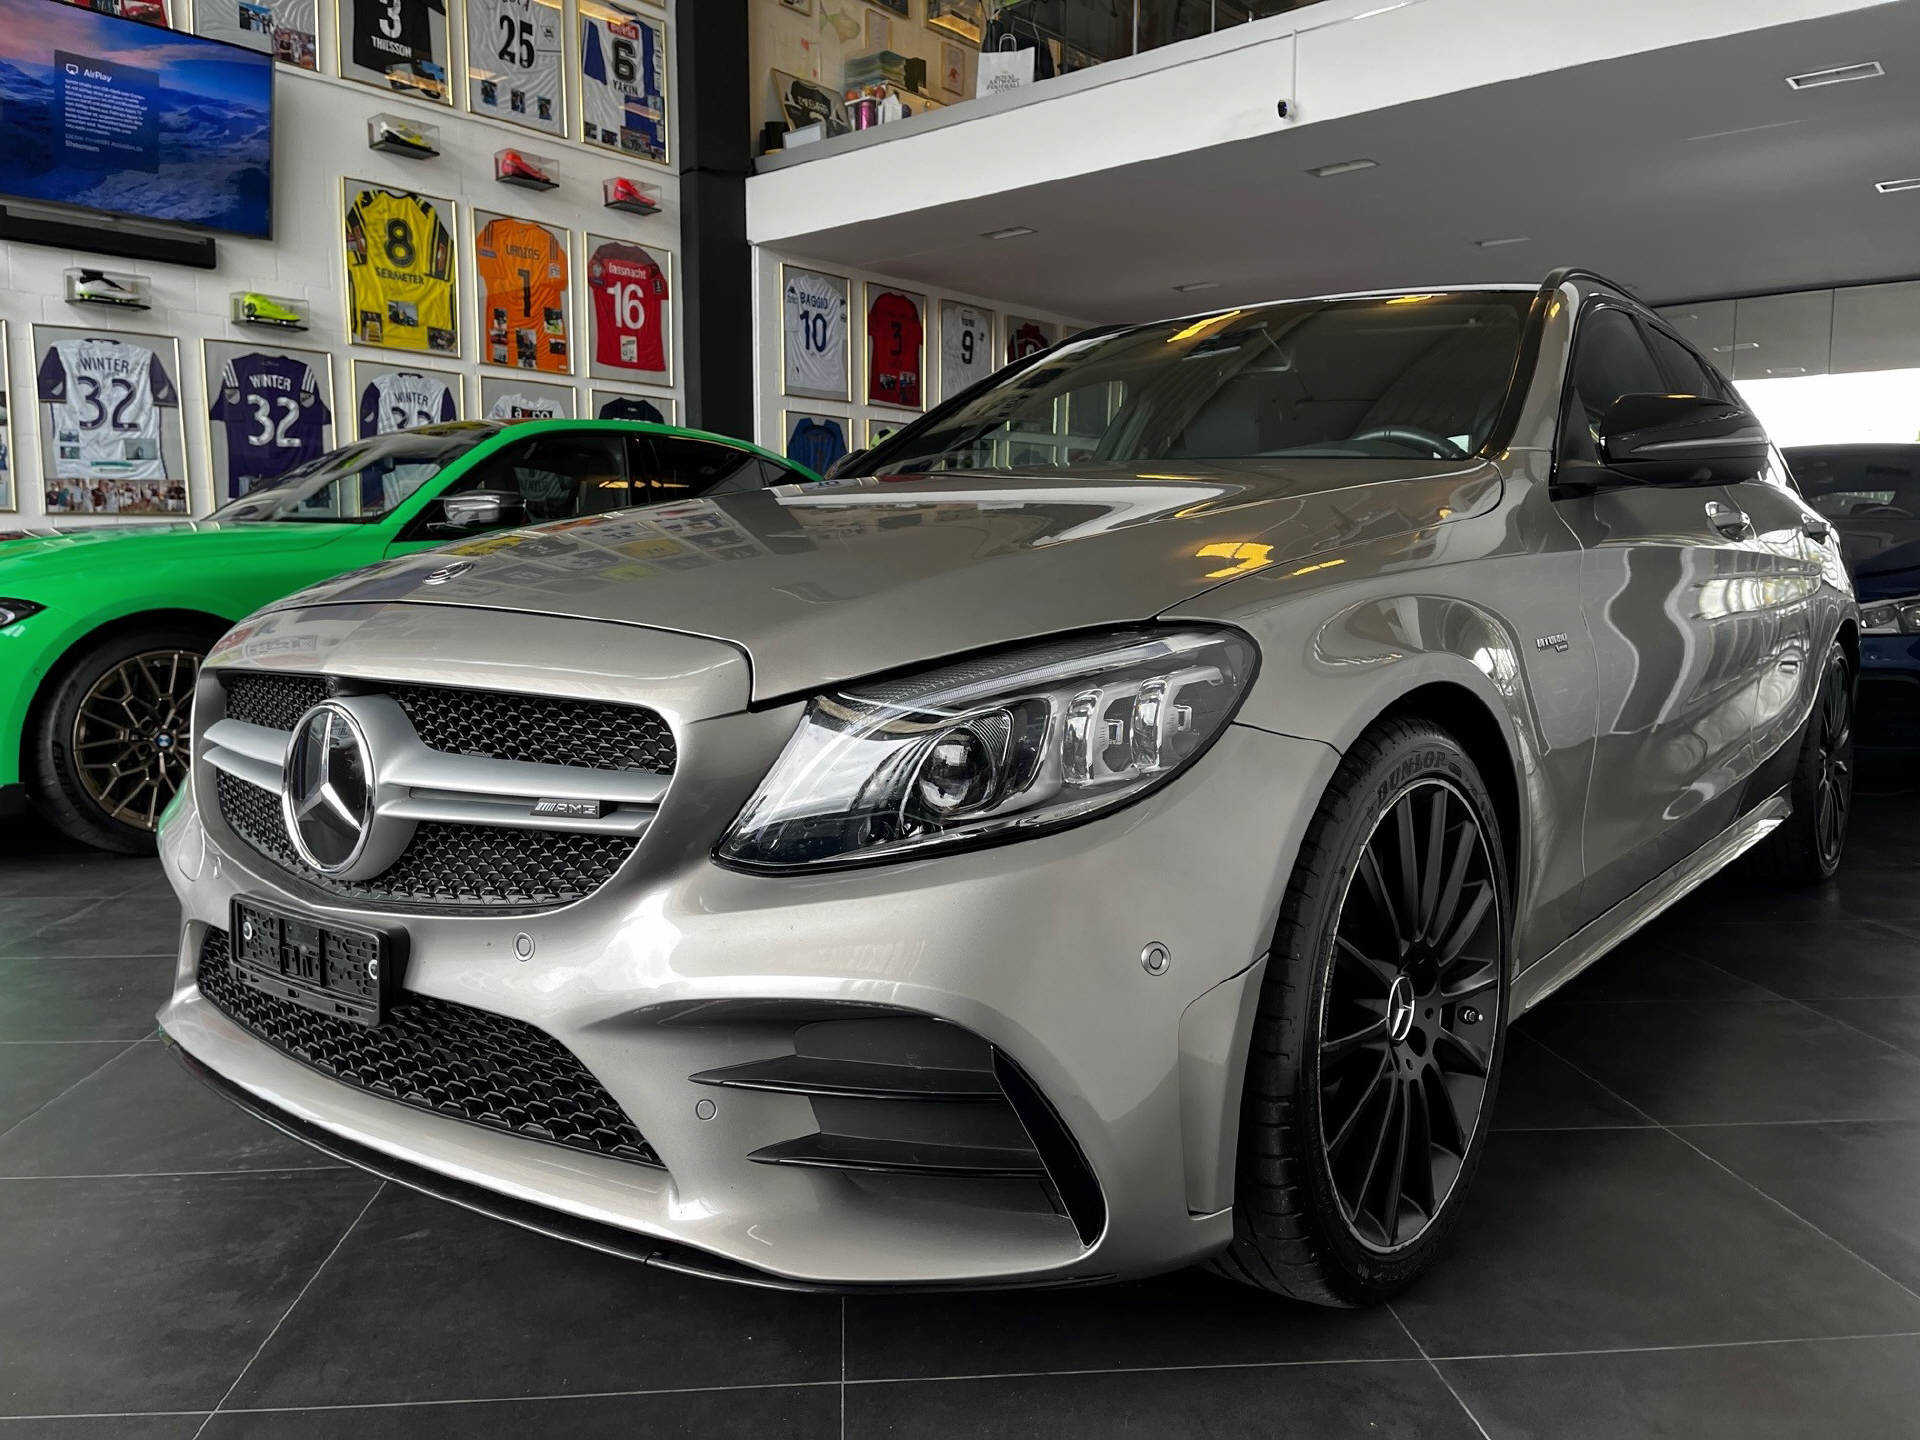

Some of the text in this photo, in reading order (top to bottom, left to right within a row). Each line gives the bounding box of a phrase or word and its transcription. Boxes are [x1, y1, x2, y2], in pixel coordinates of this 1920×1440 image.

[378, 0, 402, 38] 3
[499, 15, 535, 69] 25
[612, 38, 637, 83] 6
[84, 69, 112, 83] AirPlay
[613, 80, 639, 96] YAKIN
[384, 217, 416, 268] 8
[517, 268, 531, 318] 1
[606, 281, 645, 330] 16
[800, 292, 828, 310] BAGGIO
[800, 310, 827, 352] 10
[961, 330, 974, 365] 9
[80, 357, 130, 374] WINTER
[249, 374, 292, 392] WINTER
[77, 376, 141, 431] 32
[394, 391, 429, 406] WINTER
[247, 394, 302, 447] 32
